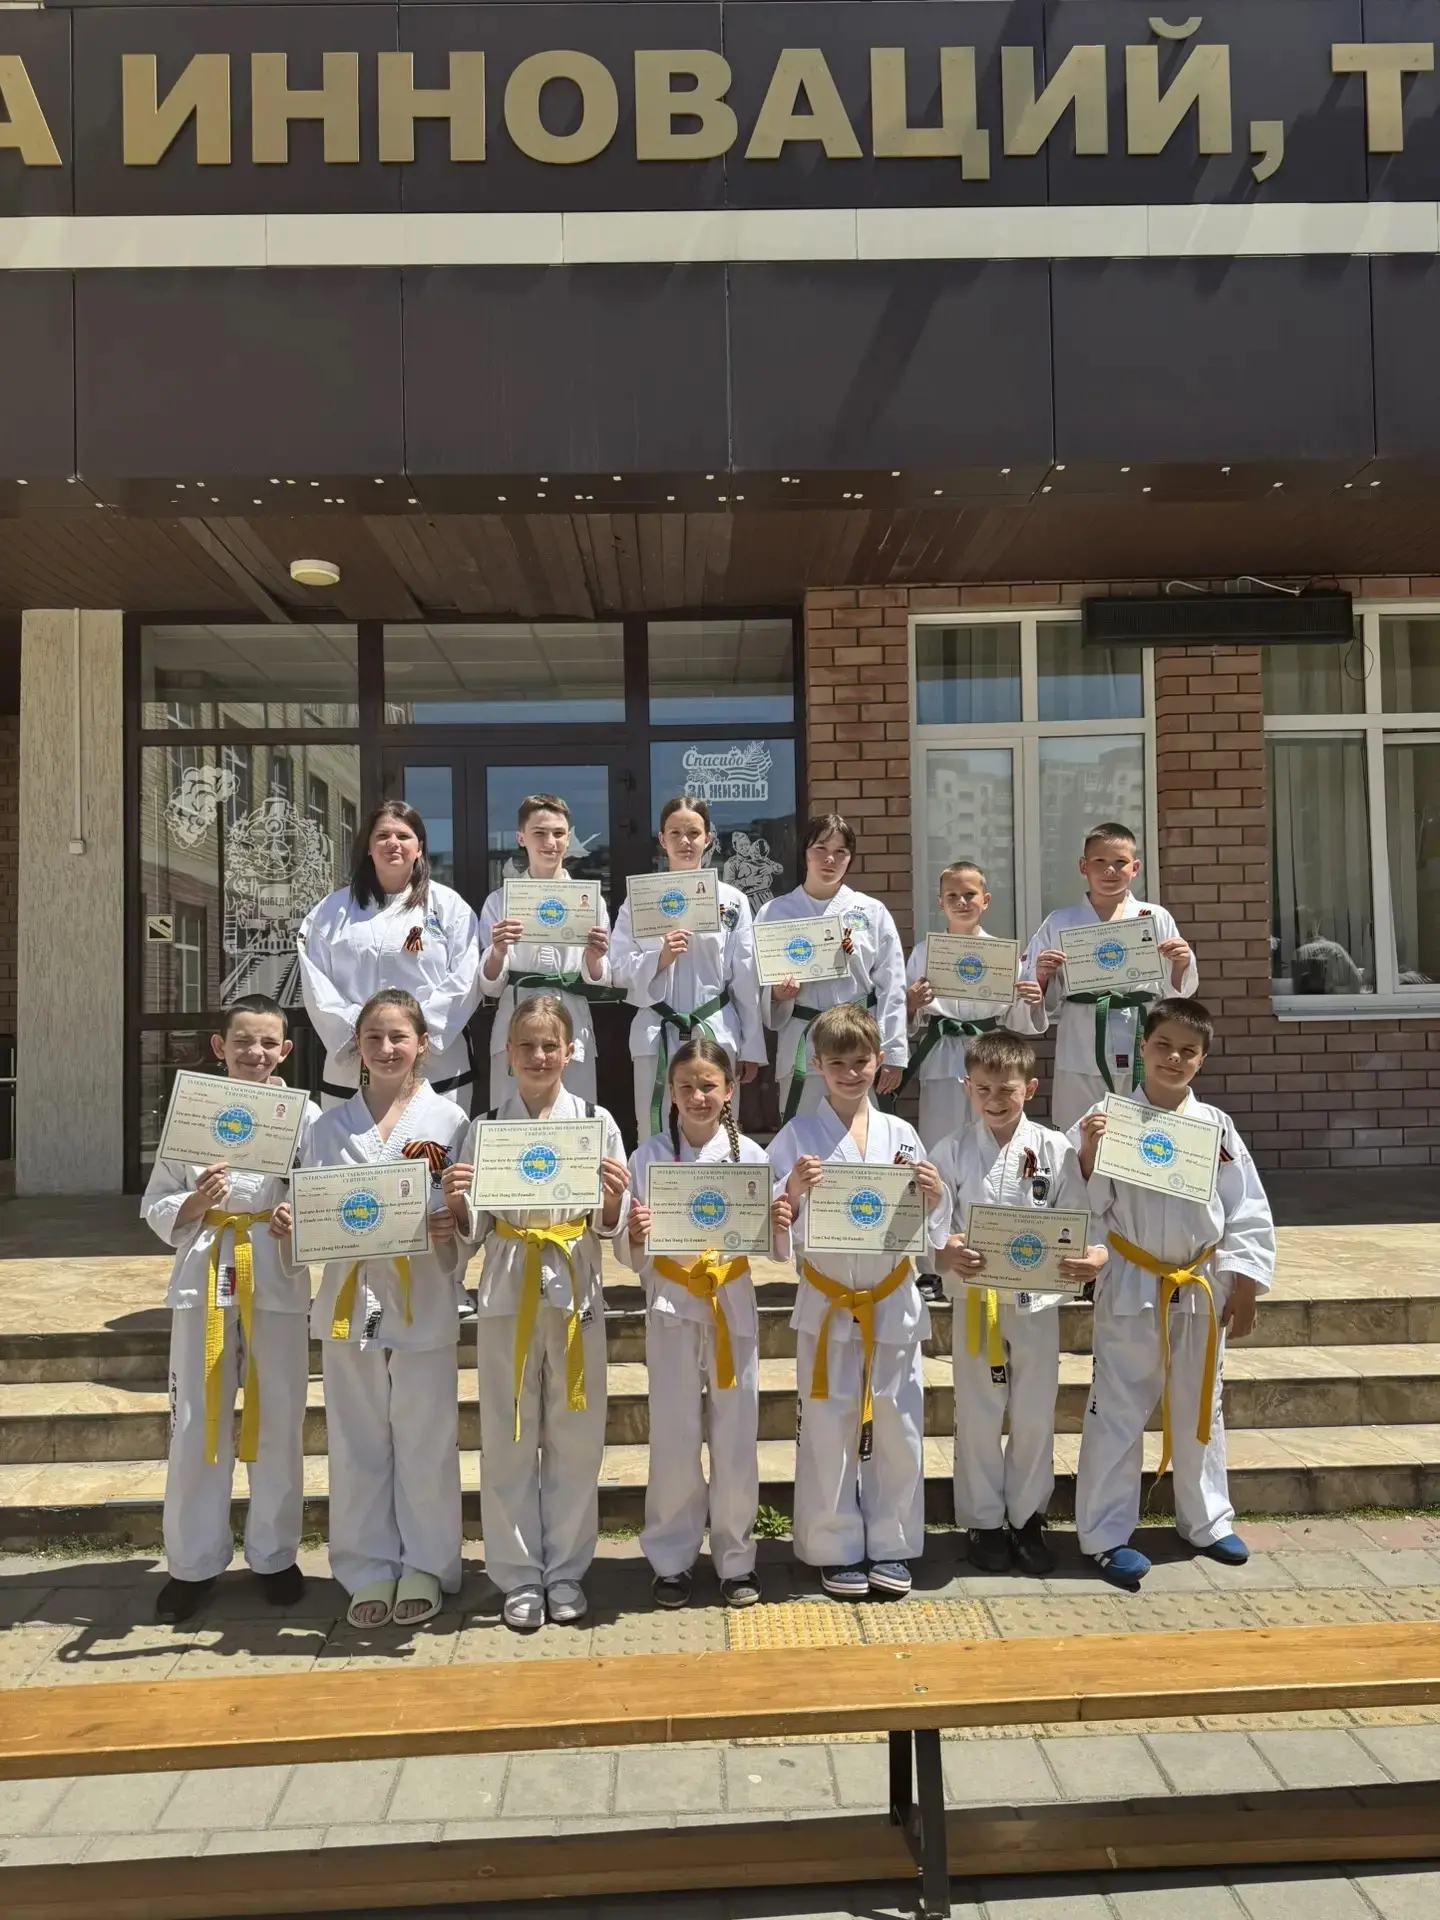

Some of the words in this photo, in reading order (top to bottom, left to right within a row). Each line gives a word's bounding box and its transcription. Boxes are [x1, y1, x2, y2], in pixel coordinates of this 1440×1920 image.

[121, 16, 1283, 182] ИННОВАЦИЙ,
[685, 751, 744, 768] Спасибо
[687, 784, 706, 798] ЗА
[709, 783, 766, 799] ЖИЗНЬ!
[900, 1143, 914, 1152] ITF
